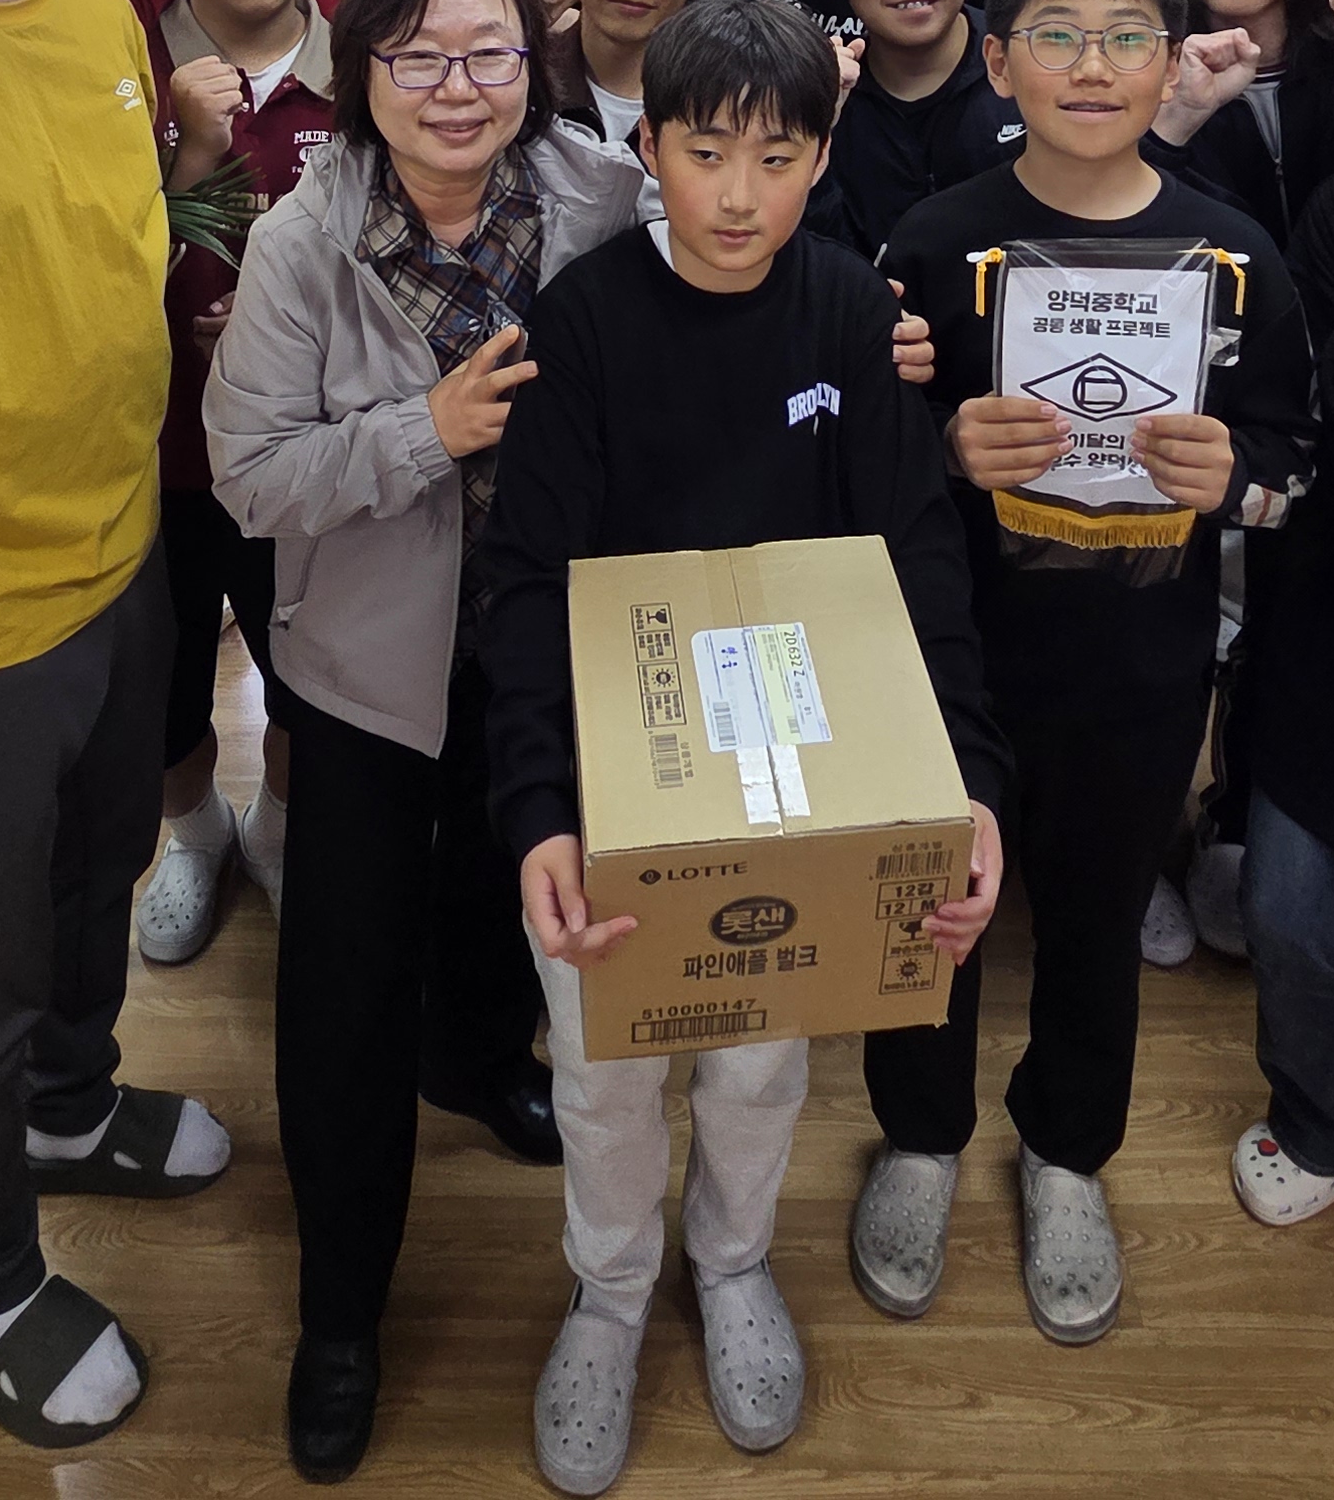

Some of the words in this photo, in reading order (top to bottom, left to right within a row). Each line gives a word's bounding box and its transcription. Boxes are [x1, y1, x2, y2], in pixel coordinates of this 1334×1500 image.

[294, 131, 330, 144] MADE
[1002, 123, 1024, 136] NIKE
[1047, 290, 1158, 315] 양덕중학교
[1033, 317, 1065, 334] 공동
[1069, 318, 1102, 336] 생활
[1105, 319, 1171, 339] 프로젝트
[787, 382, 841, 427] BROLYN
[1067, 433, 1125, 450] 이달의
[667, 861, 749, 881] LOTTE
[884, 902, 906, 916] 12
[720, 906, 786, 935] 롯샌
[683, 947, 768, 981] 파인애플
[777, 944, 818, 972] 벌크
[642, 998, 757, 1020] 510000147
